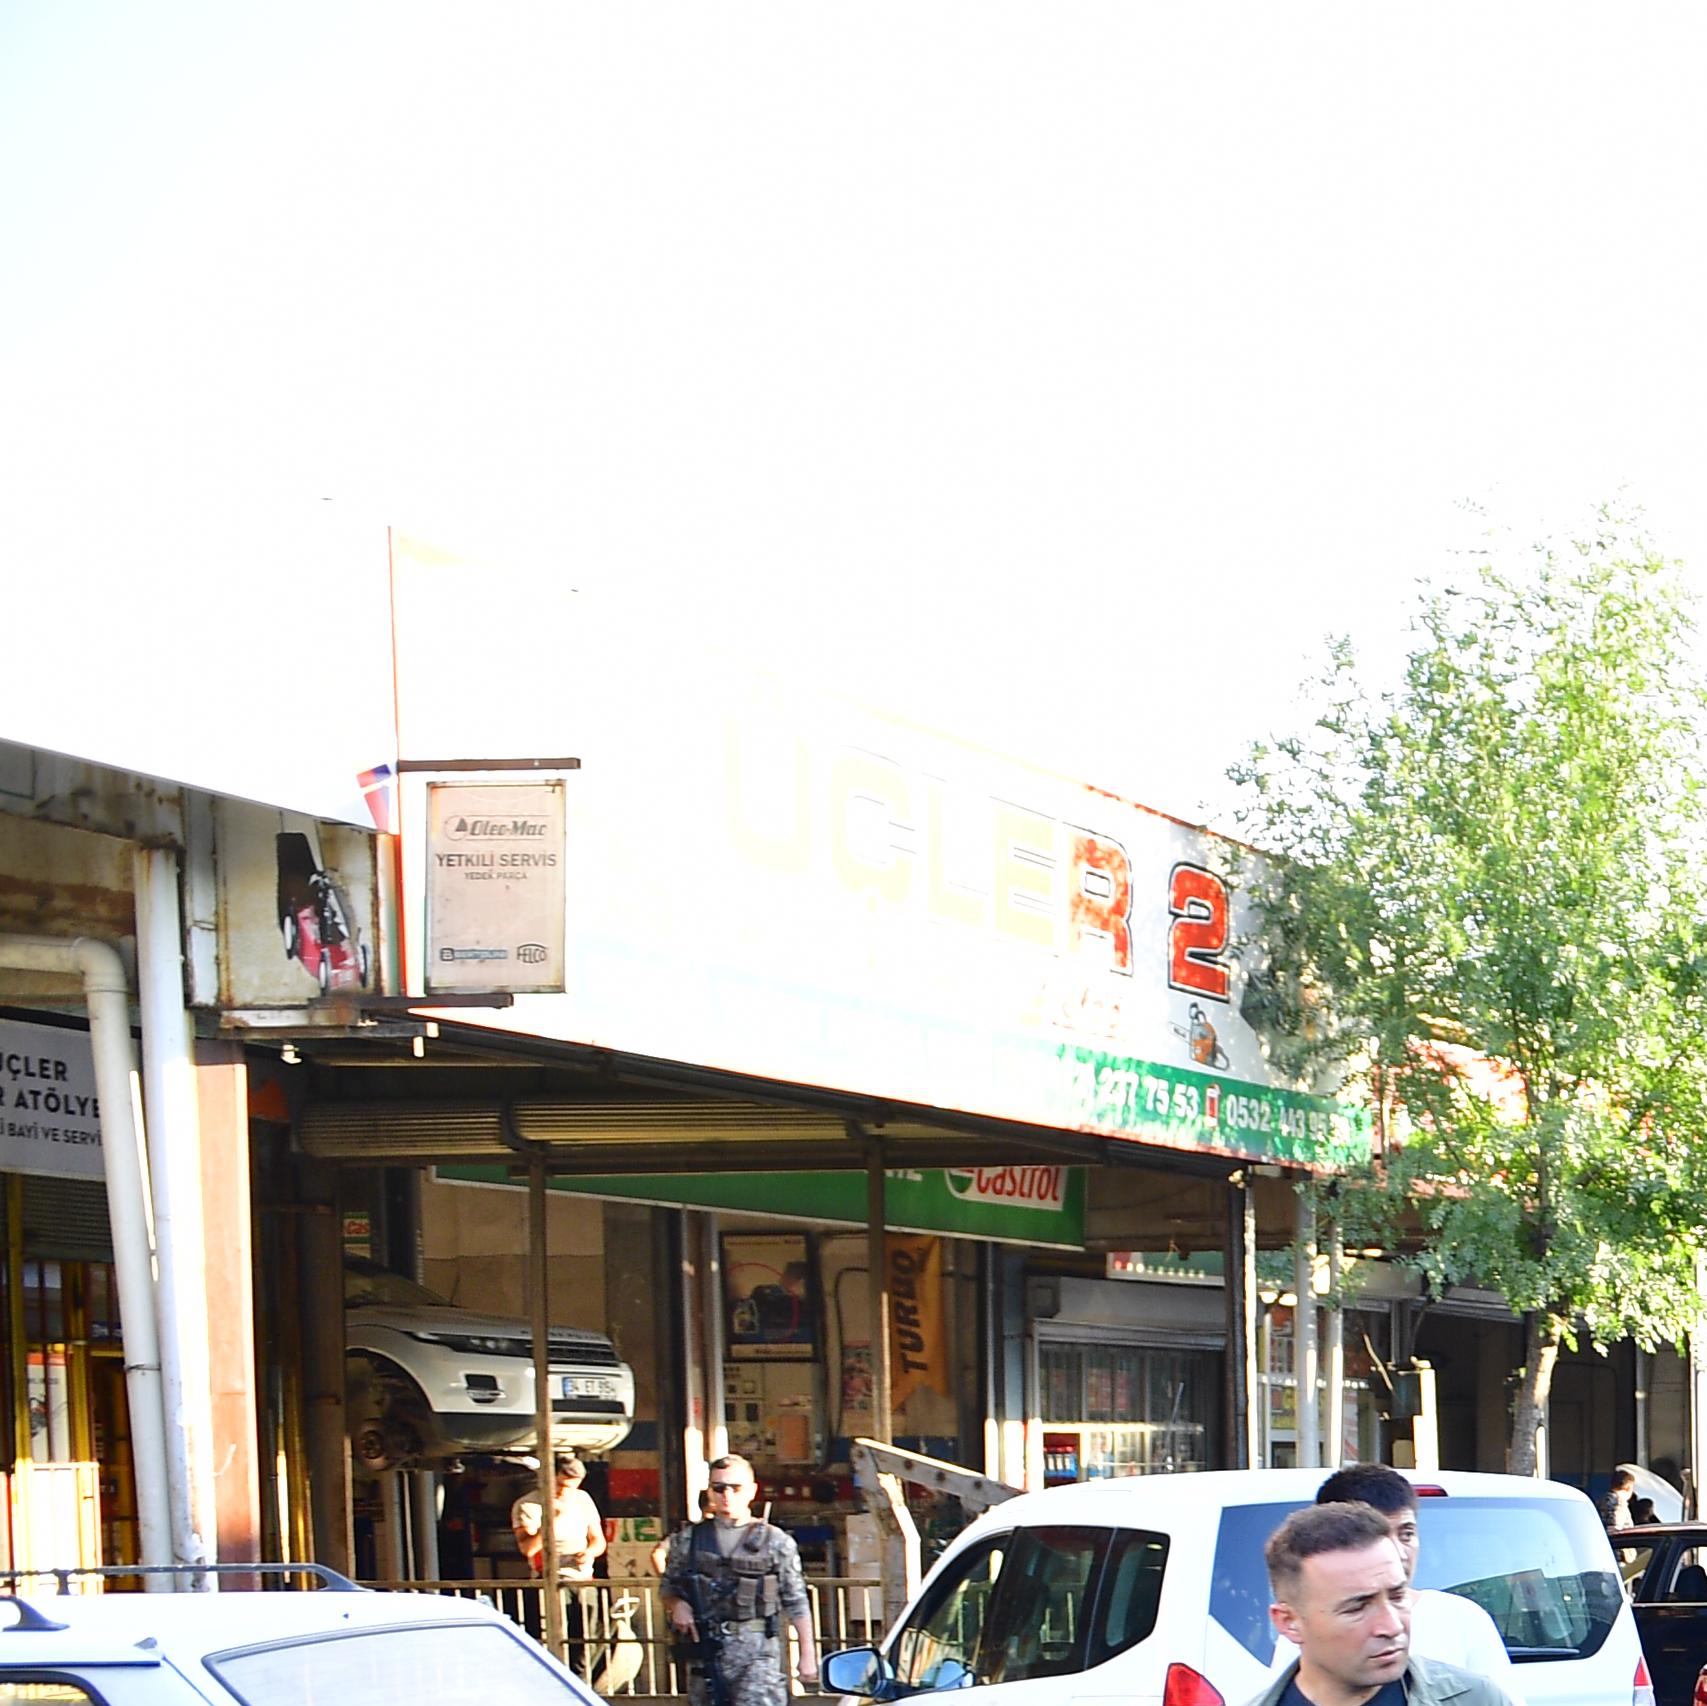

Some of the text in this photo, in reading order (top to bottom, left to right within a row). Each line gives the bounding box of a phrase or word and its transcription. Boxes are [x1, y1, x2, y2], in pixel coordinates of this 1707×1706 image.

[436, 850, 557, 867] YETKİLİ SERVİS
[1168, 861, 1232, 1003] 2
[1174, 1082, 1200, 1120] 53
[1226, 1093, 1271, 1132] 0532
[42, 1126, 60, 1143] VE
[890, 1250, 929, 1375] TURBO
